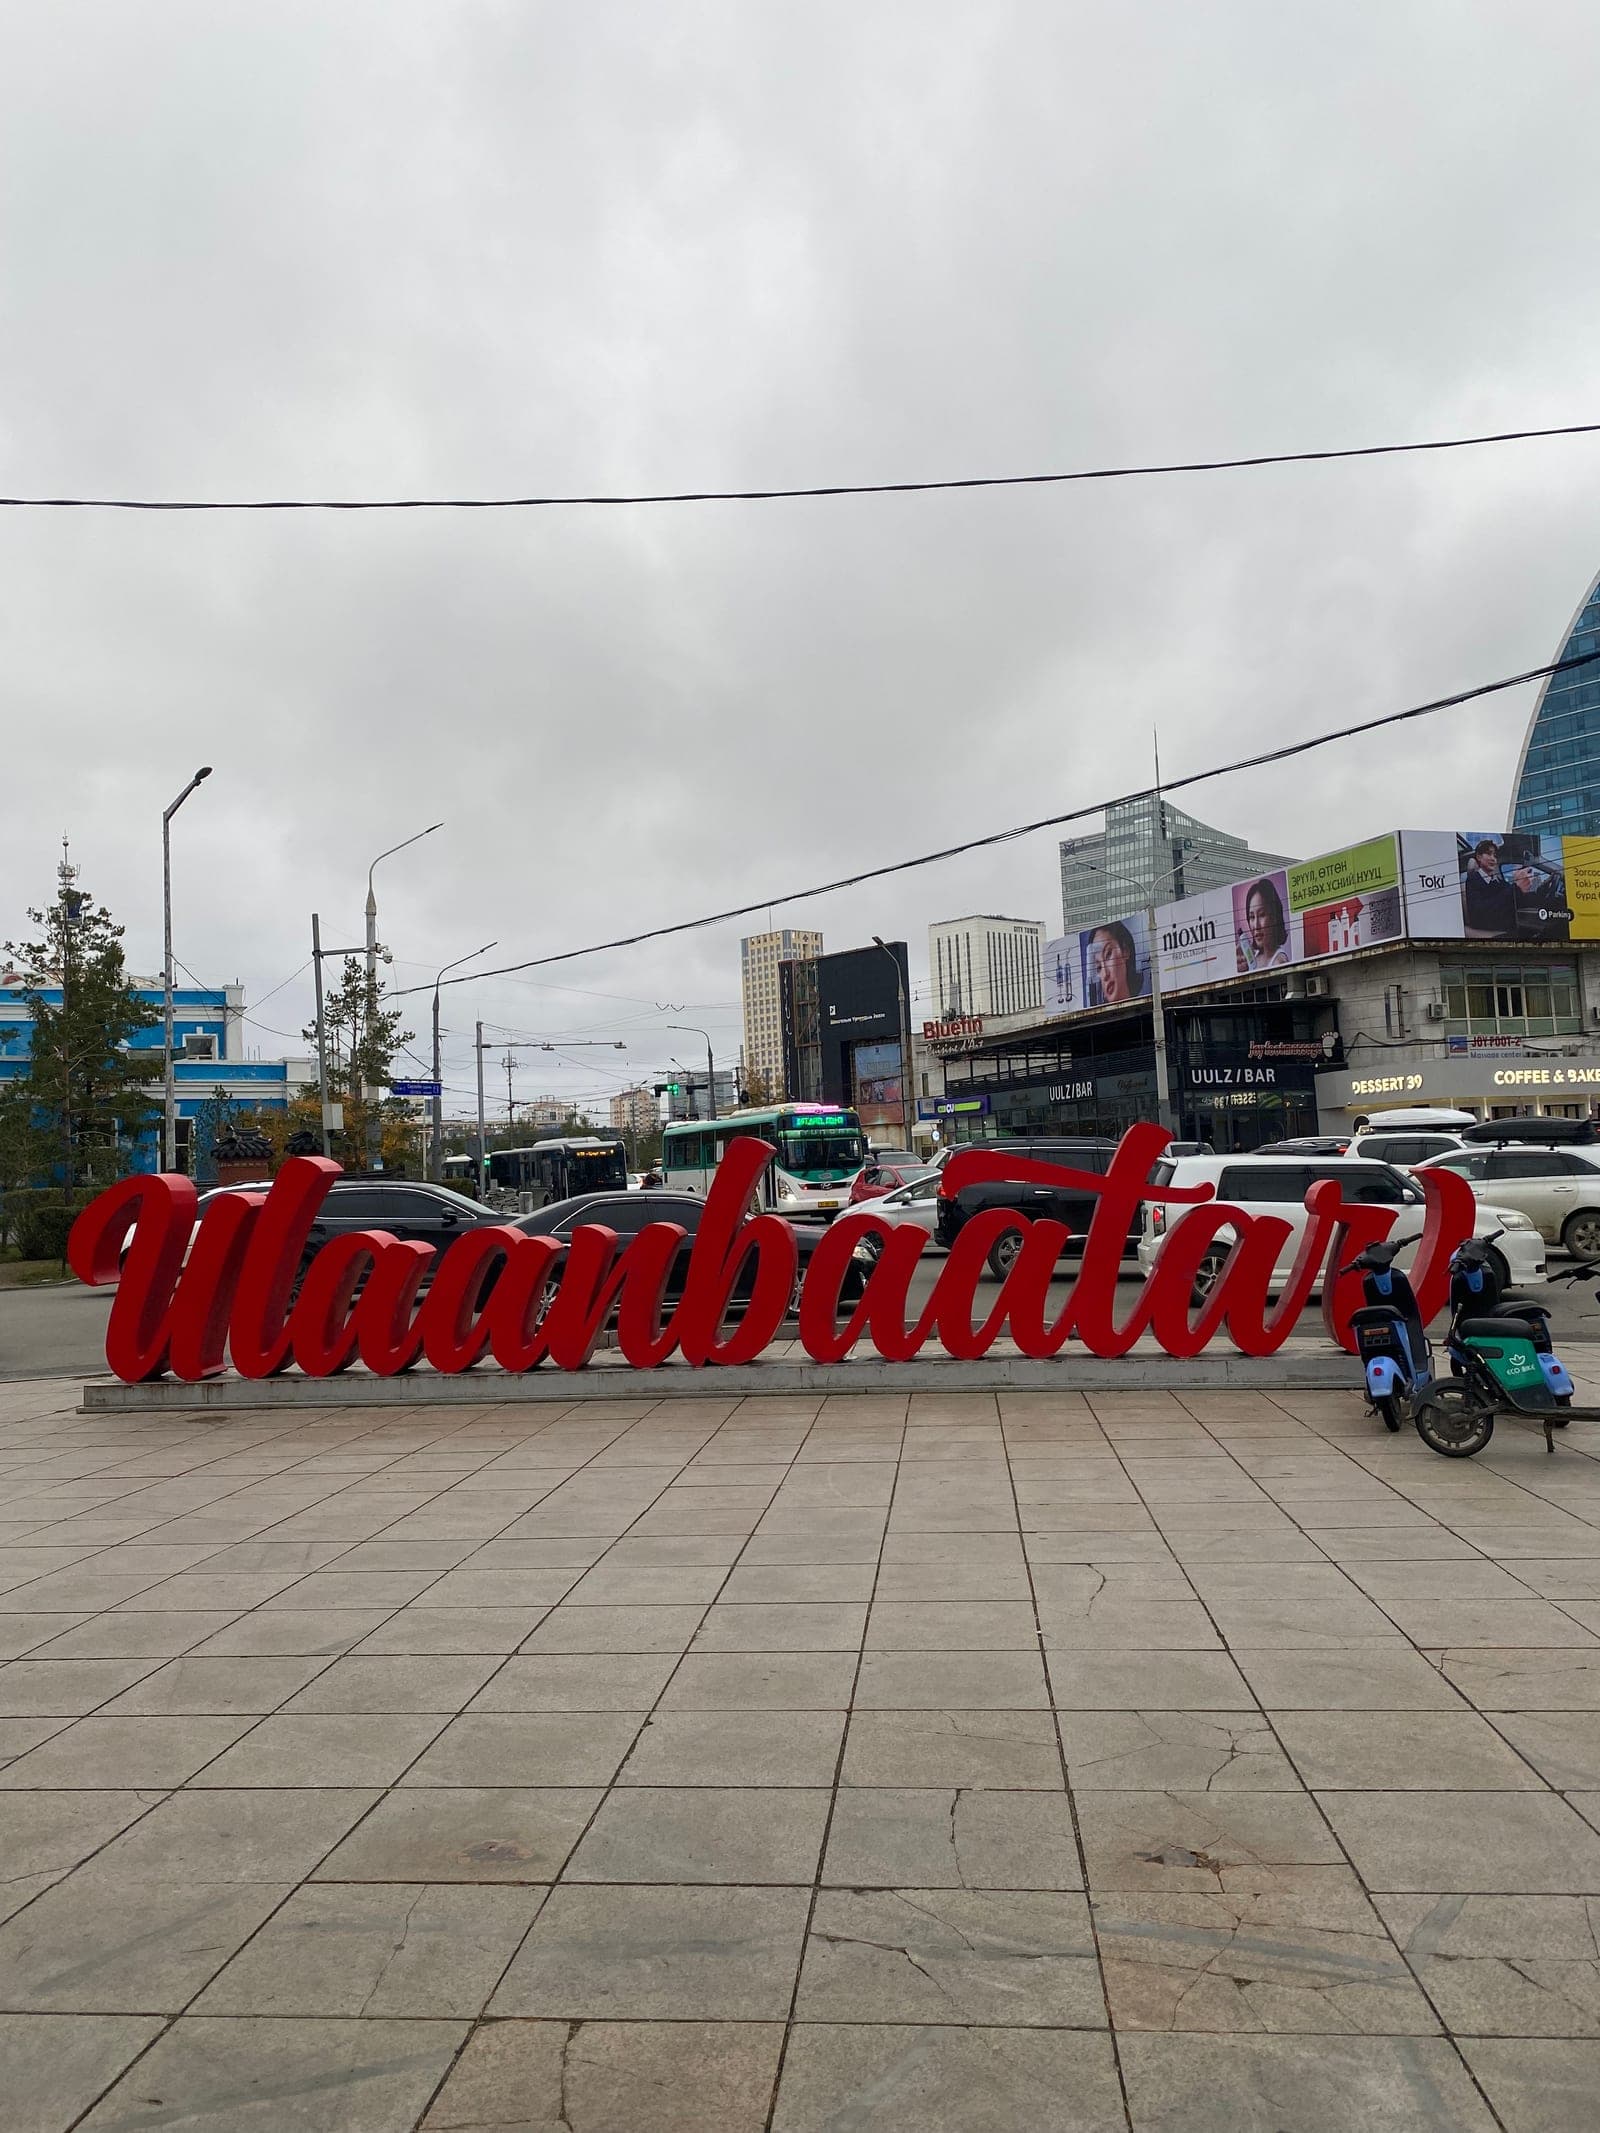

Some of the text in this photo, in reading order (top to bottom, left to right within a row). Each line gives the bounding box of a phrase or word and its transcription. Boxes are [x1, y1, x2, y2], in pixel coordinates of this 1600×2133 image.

[1318, 861, 1348, 878] ӨТГӨН
[1419, 874, 1445, 889] Toki
[1163, 915, 1217, 951] nioxin
[923, 1016, 984, 1039] Bluefin
[1352, 1074, 1423, 1095] DESSERT 39
[1493, 1070, 1550, 1085] COFFEE
[1553, 1069, 1565, 1083] &
